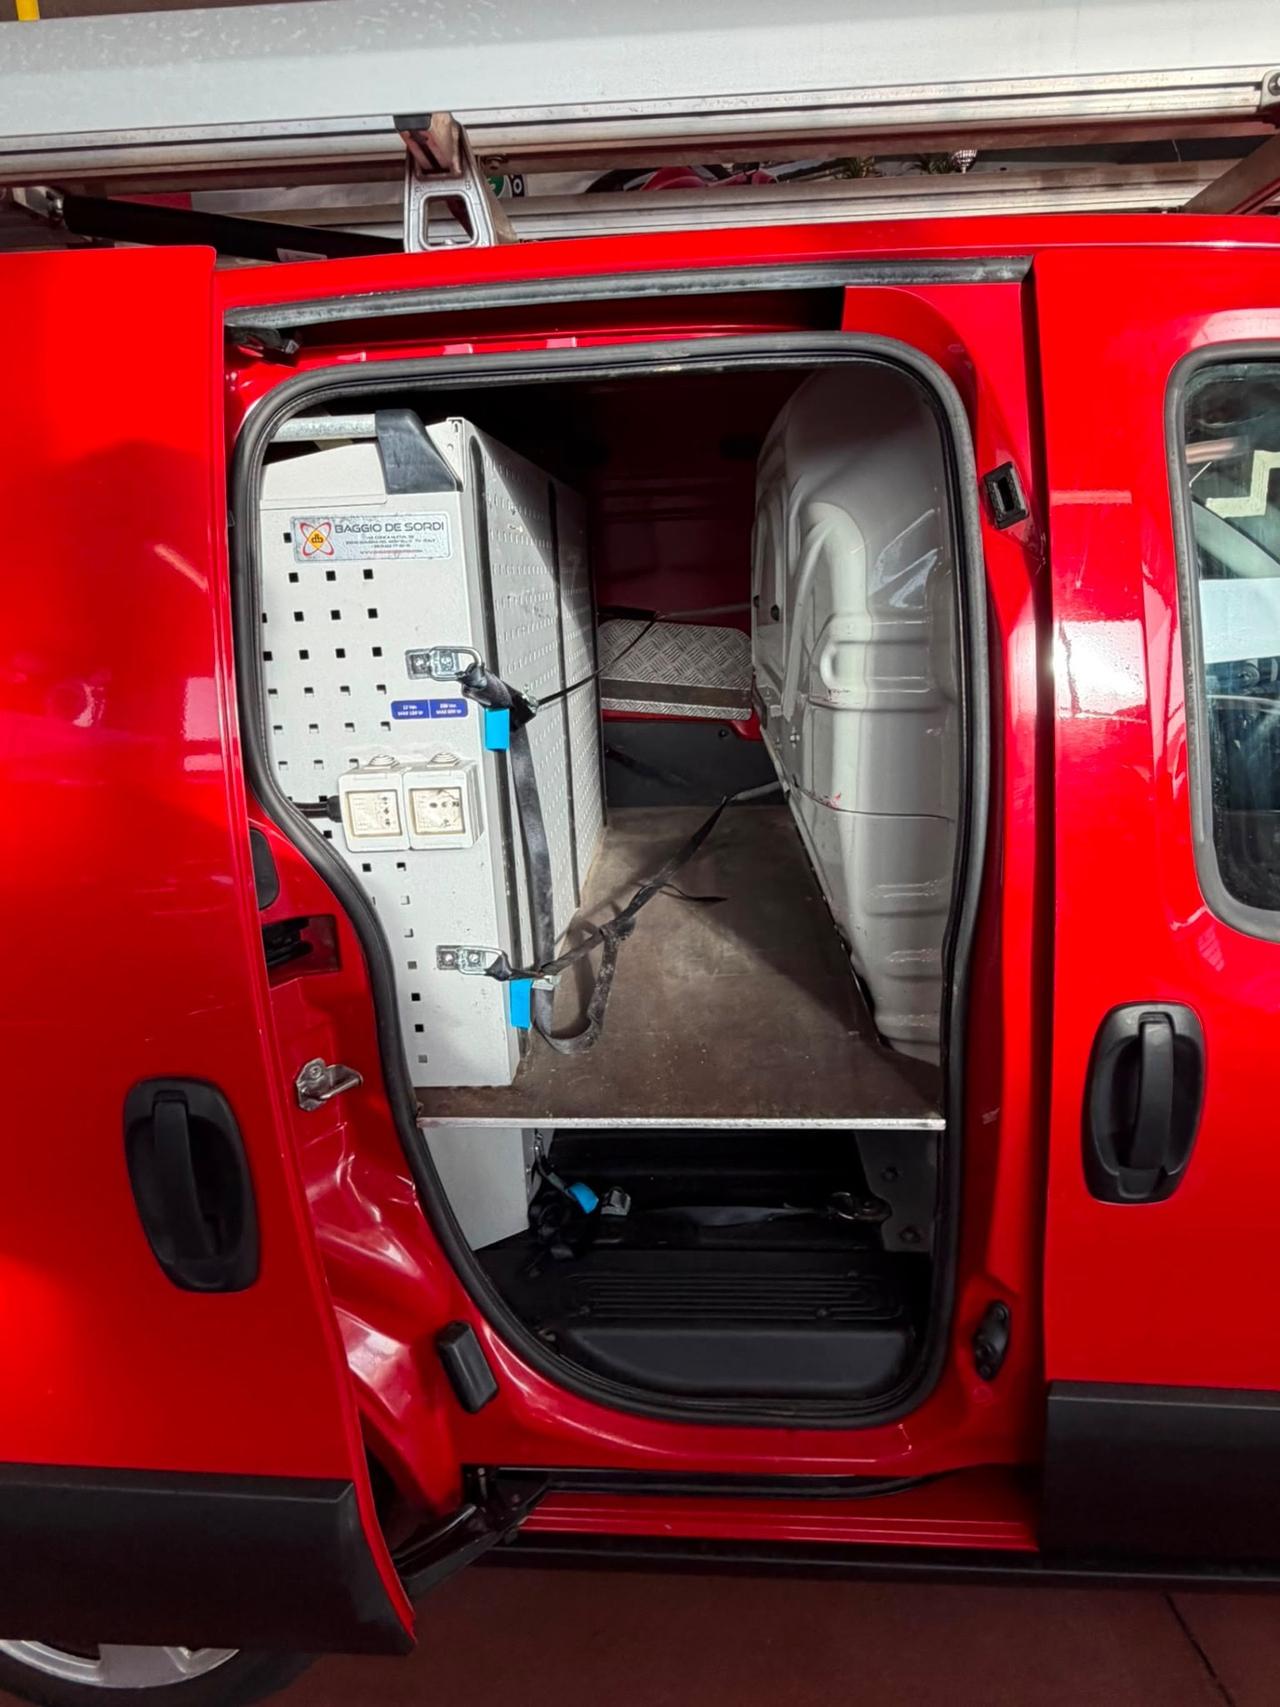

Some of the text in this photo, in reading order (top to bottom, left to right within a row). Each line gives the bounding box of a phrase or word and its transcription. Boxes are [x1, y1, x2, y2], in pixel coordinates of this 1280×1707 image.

[334, 521, 445, 533] BAGGIO DE SORDI
